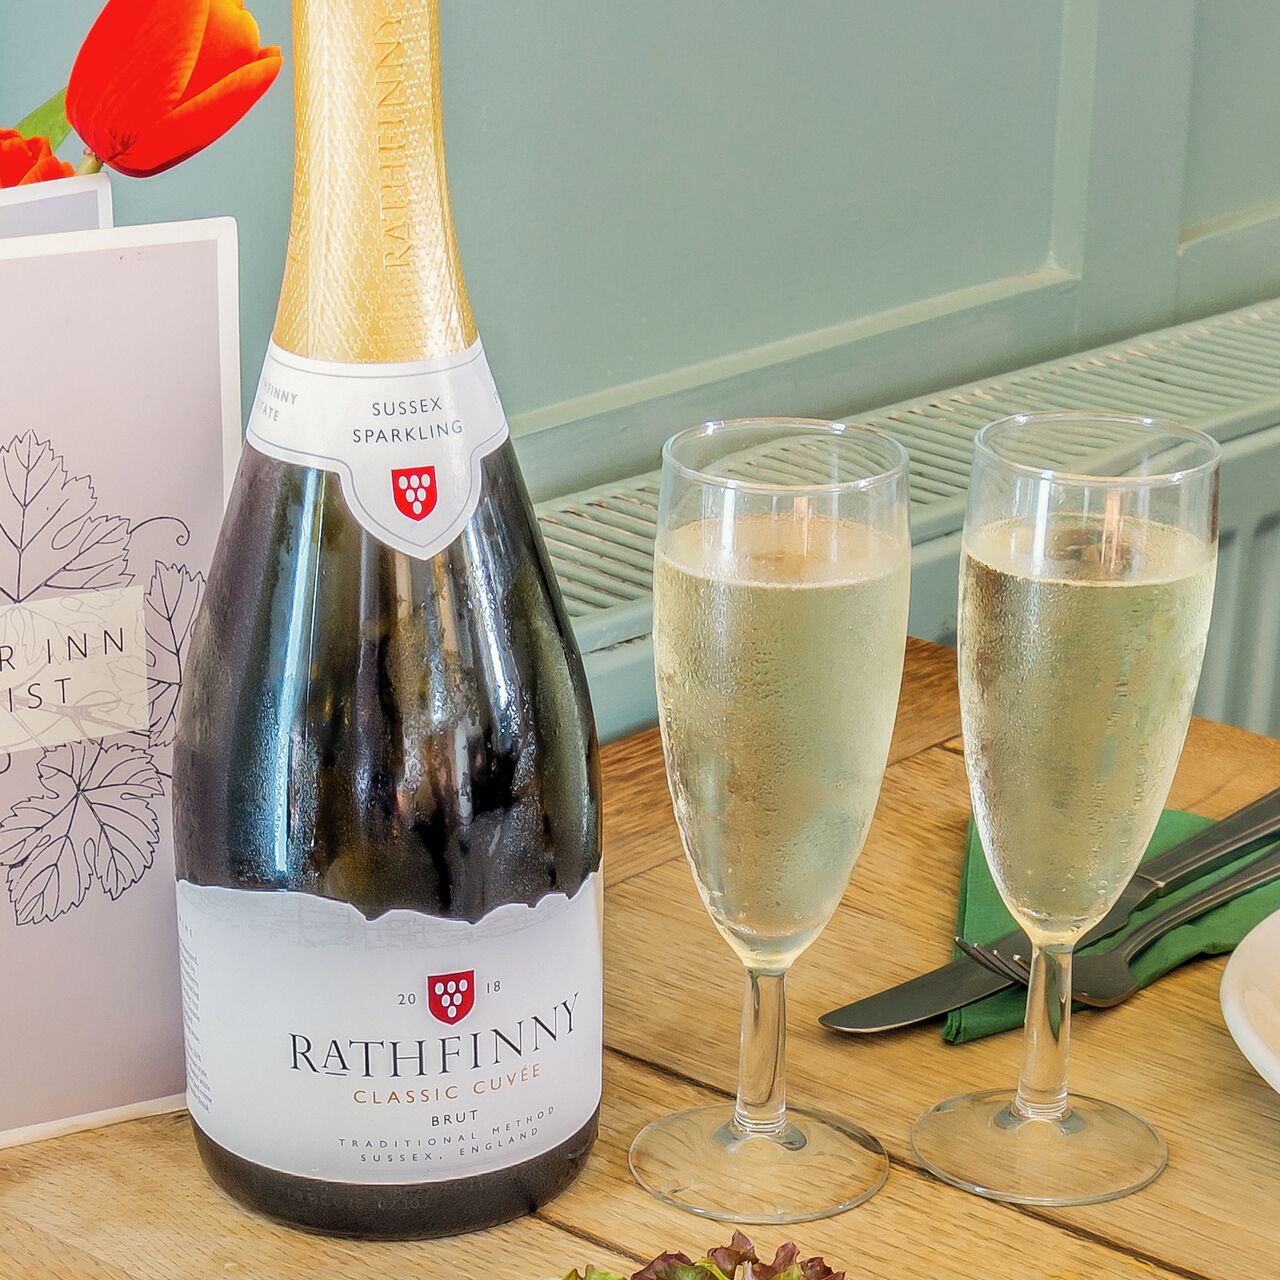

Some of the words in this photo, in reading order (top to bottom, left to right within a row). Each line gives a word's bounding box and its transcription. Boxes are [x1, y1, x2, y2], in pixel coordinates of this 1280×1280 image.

[373, 13, 412, 271] RATHFINNY
[372, 396, 443, 416] SUSSEX
[352, 419, 464, 444] SPARKLING
[47, 627, 126, 665] INN
[397, 993, 417, 1006] 20
[486, 980, 502, 994] 18
[288, 991, 580, 1078] RATHFINNY
[353, 1085, 459, 1105] CLASSIC
[473, 1063, 541, 1095] CUVÉE
[339, 1131, 477, 1149] TRADITIONAL
[492, 1105, 555, 1136] METHOD
[431, 1109, 479, 1127] BRUT
[459, 1127, 539, 1157] ENGLAND
